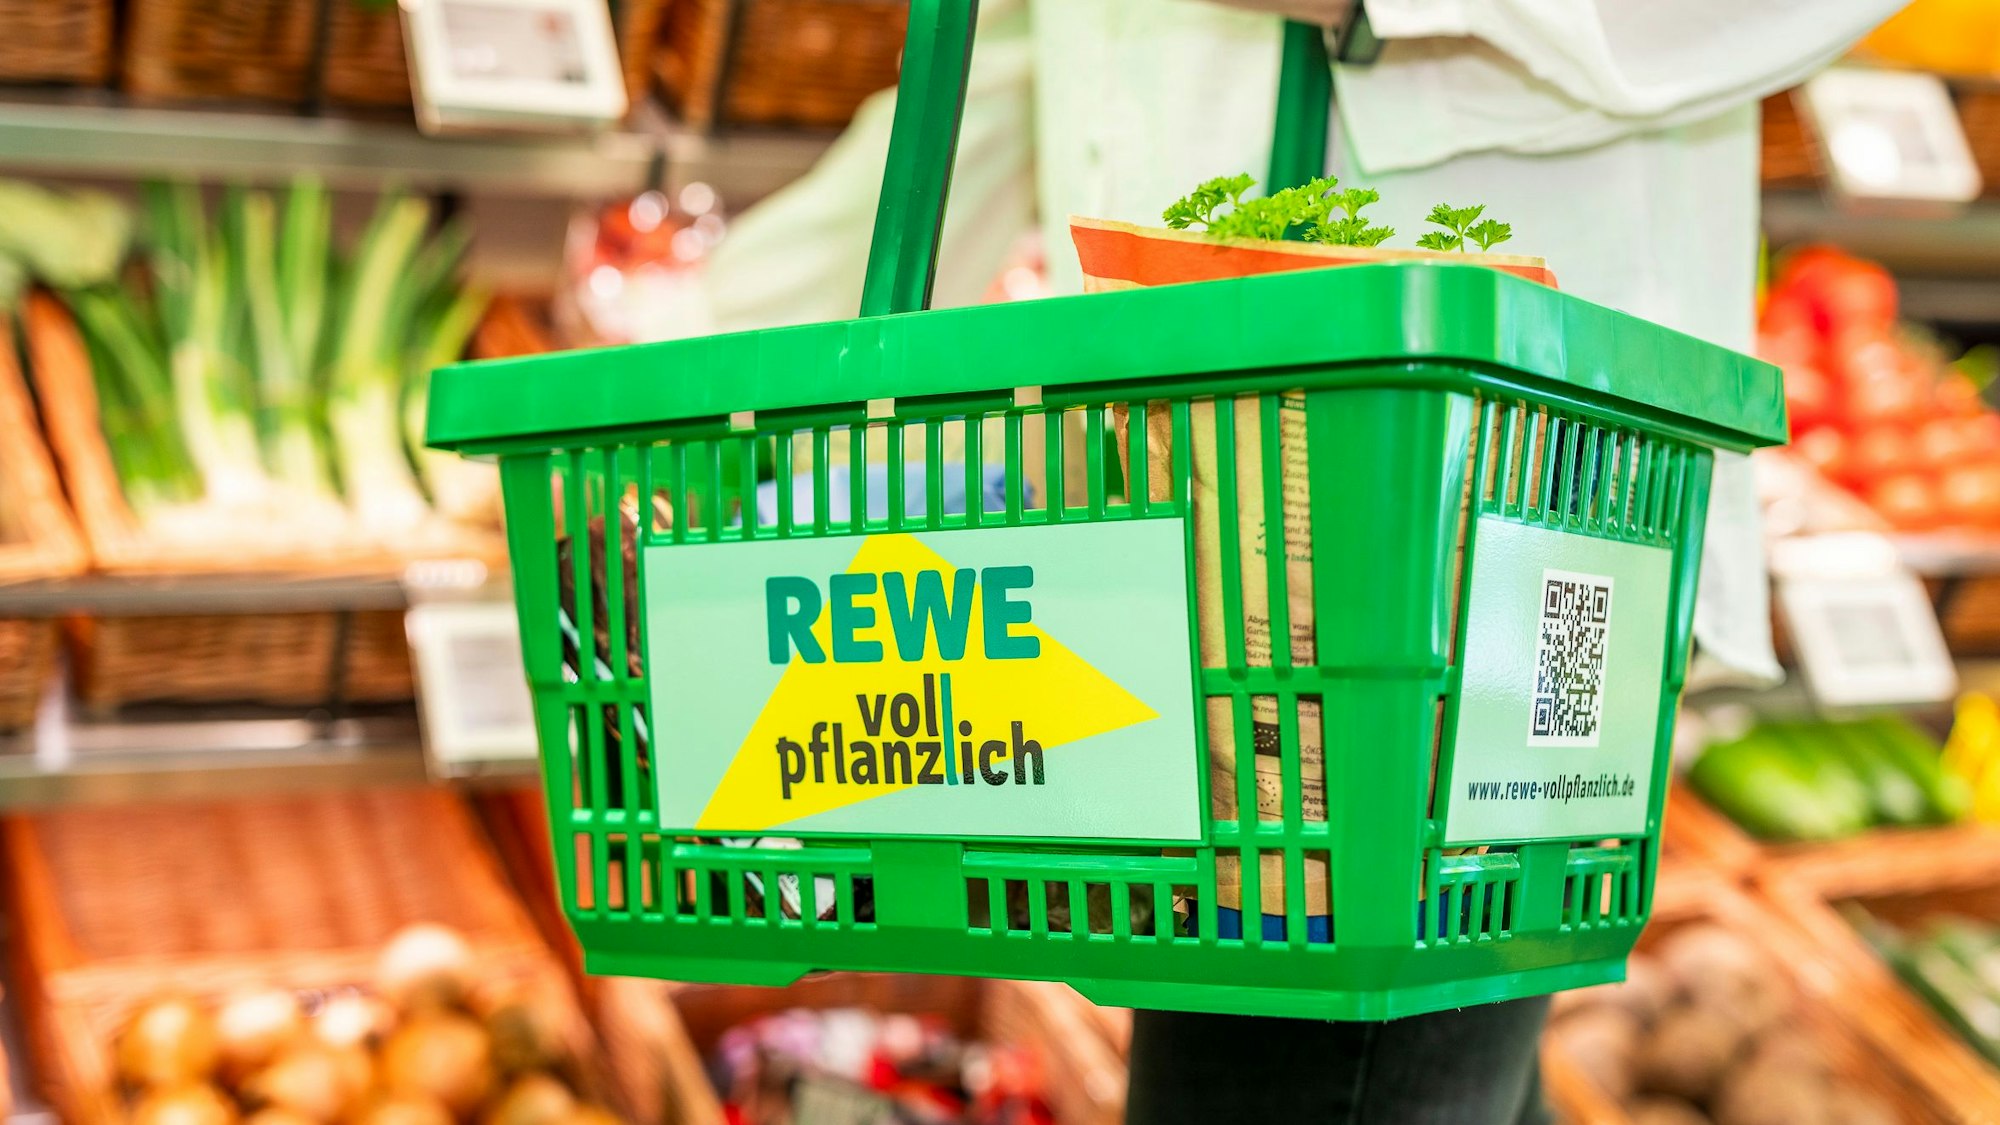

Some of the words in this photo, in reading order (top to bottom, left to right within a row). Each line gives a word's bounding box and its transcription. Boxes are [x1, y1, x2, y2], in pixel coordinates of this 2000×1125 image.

[765, 565, 1041, 665] REWE
[776, 720, 1045, 800] pflanzlich
[1468, 773, 1635, 805] www.rewe-vollpflanzlich.de
